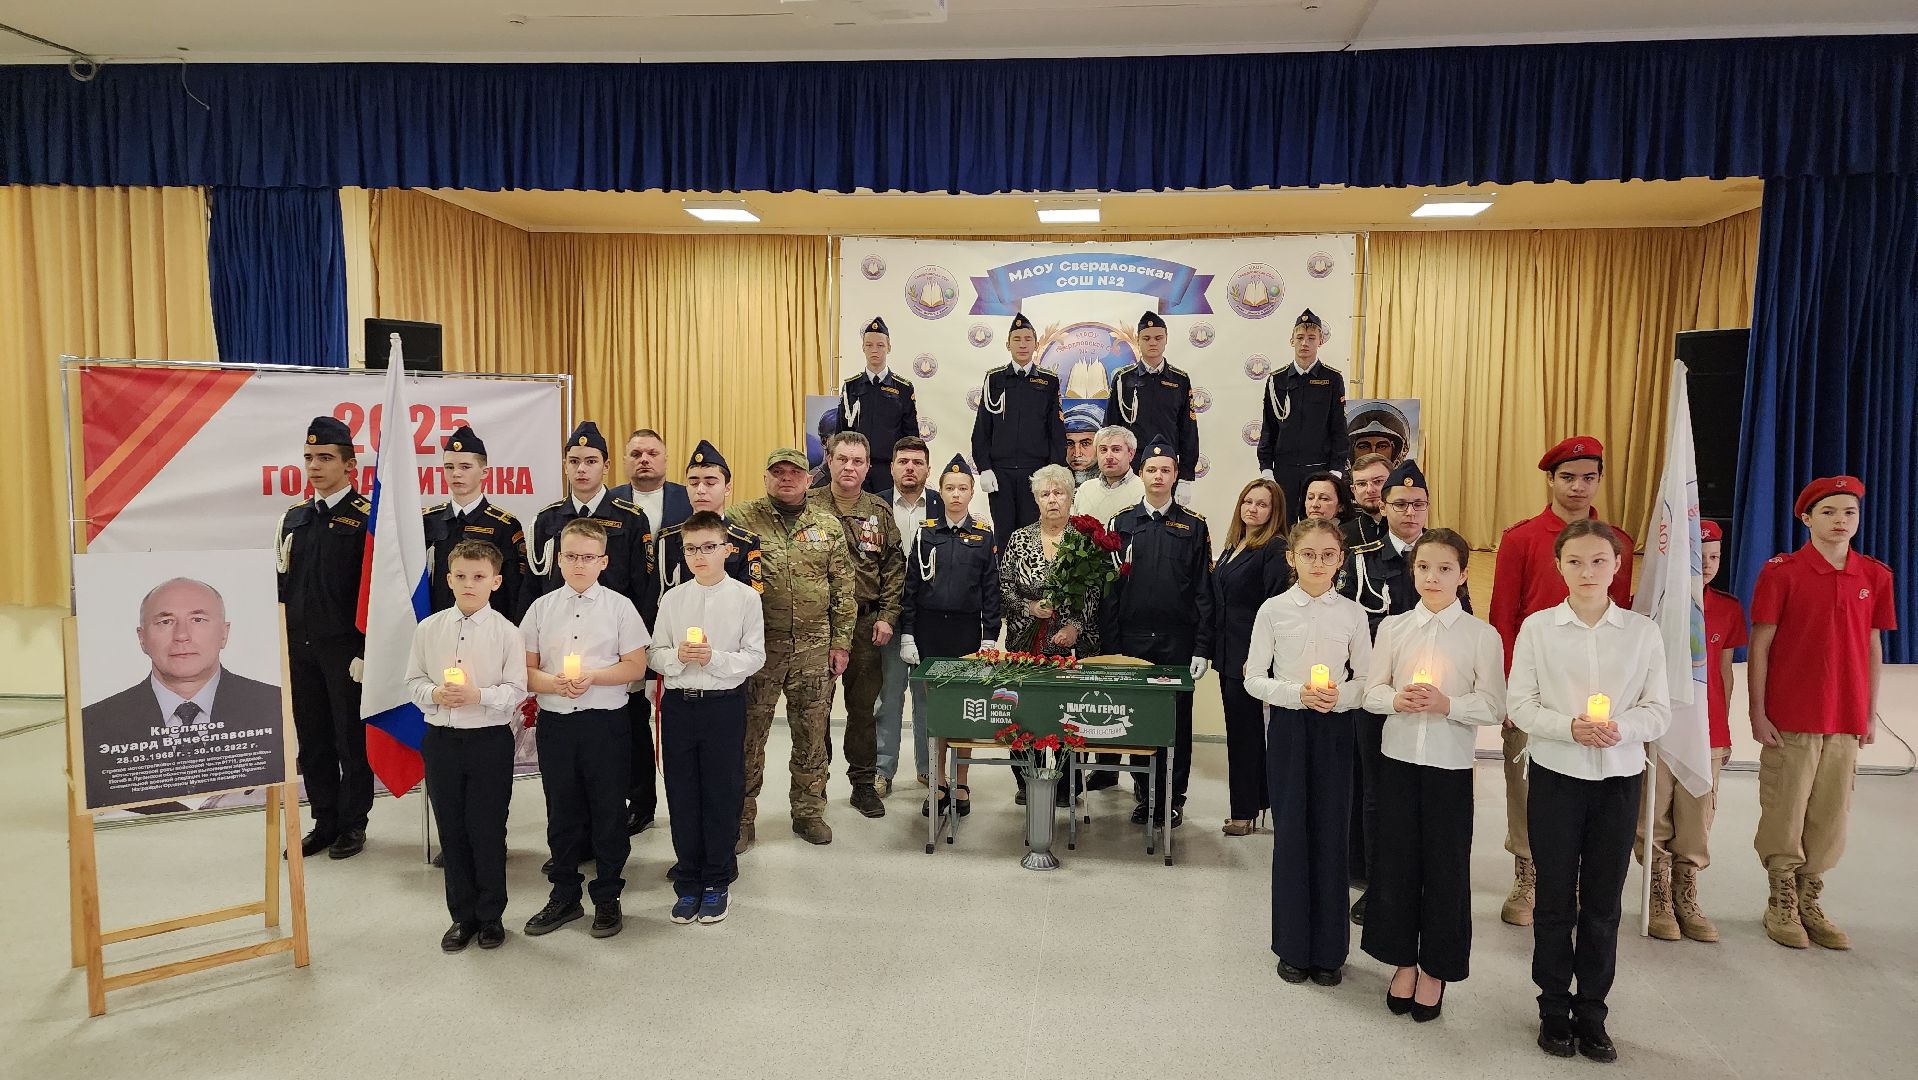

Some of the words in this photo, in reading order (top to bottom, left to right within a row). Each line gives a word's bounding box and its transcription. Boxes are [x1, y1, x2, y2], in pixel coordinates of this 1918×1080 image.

[1008, 262, 1054, 282] МАОУ
[1059, 260, 1174, 282] Свердловская
[1056, 275, 1094, 288] СОШ
[1098, 275, 1125, 288] №2
[262, 464, 317, 501] ГО
[346, 464, 534, 496] ЗАИТИКА
[1658, 516, 1668, 556] АОУ
[990, 703, 1013, 711] ПРОЕКТ
[1066, 702, 1097, 713] ПАРТА
[1097, 704, 1126, 716] ГЕРОЯ
[150, 721, 225, 737] Кисляков
[99, 740, 159, 756] Эдуард
[162, 727, 273, 747] Вячеславович
[116, 751, 174, 764] 28.03.1968
[193, 742, 248, 755] 30.10.2022
